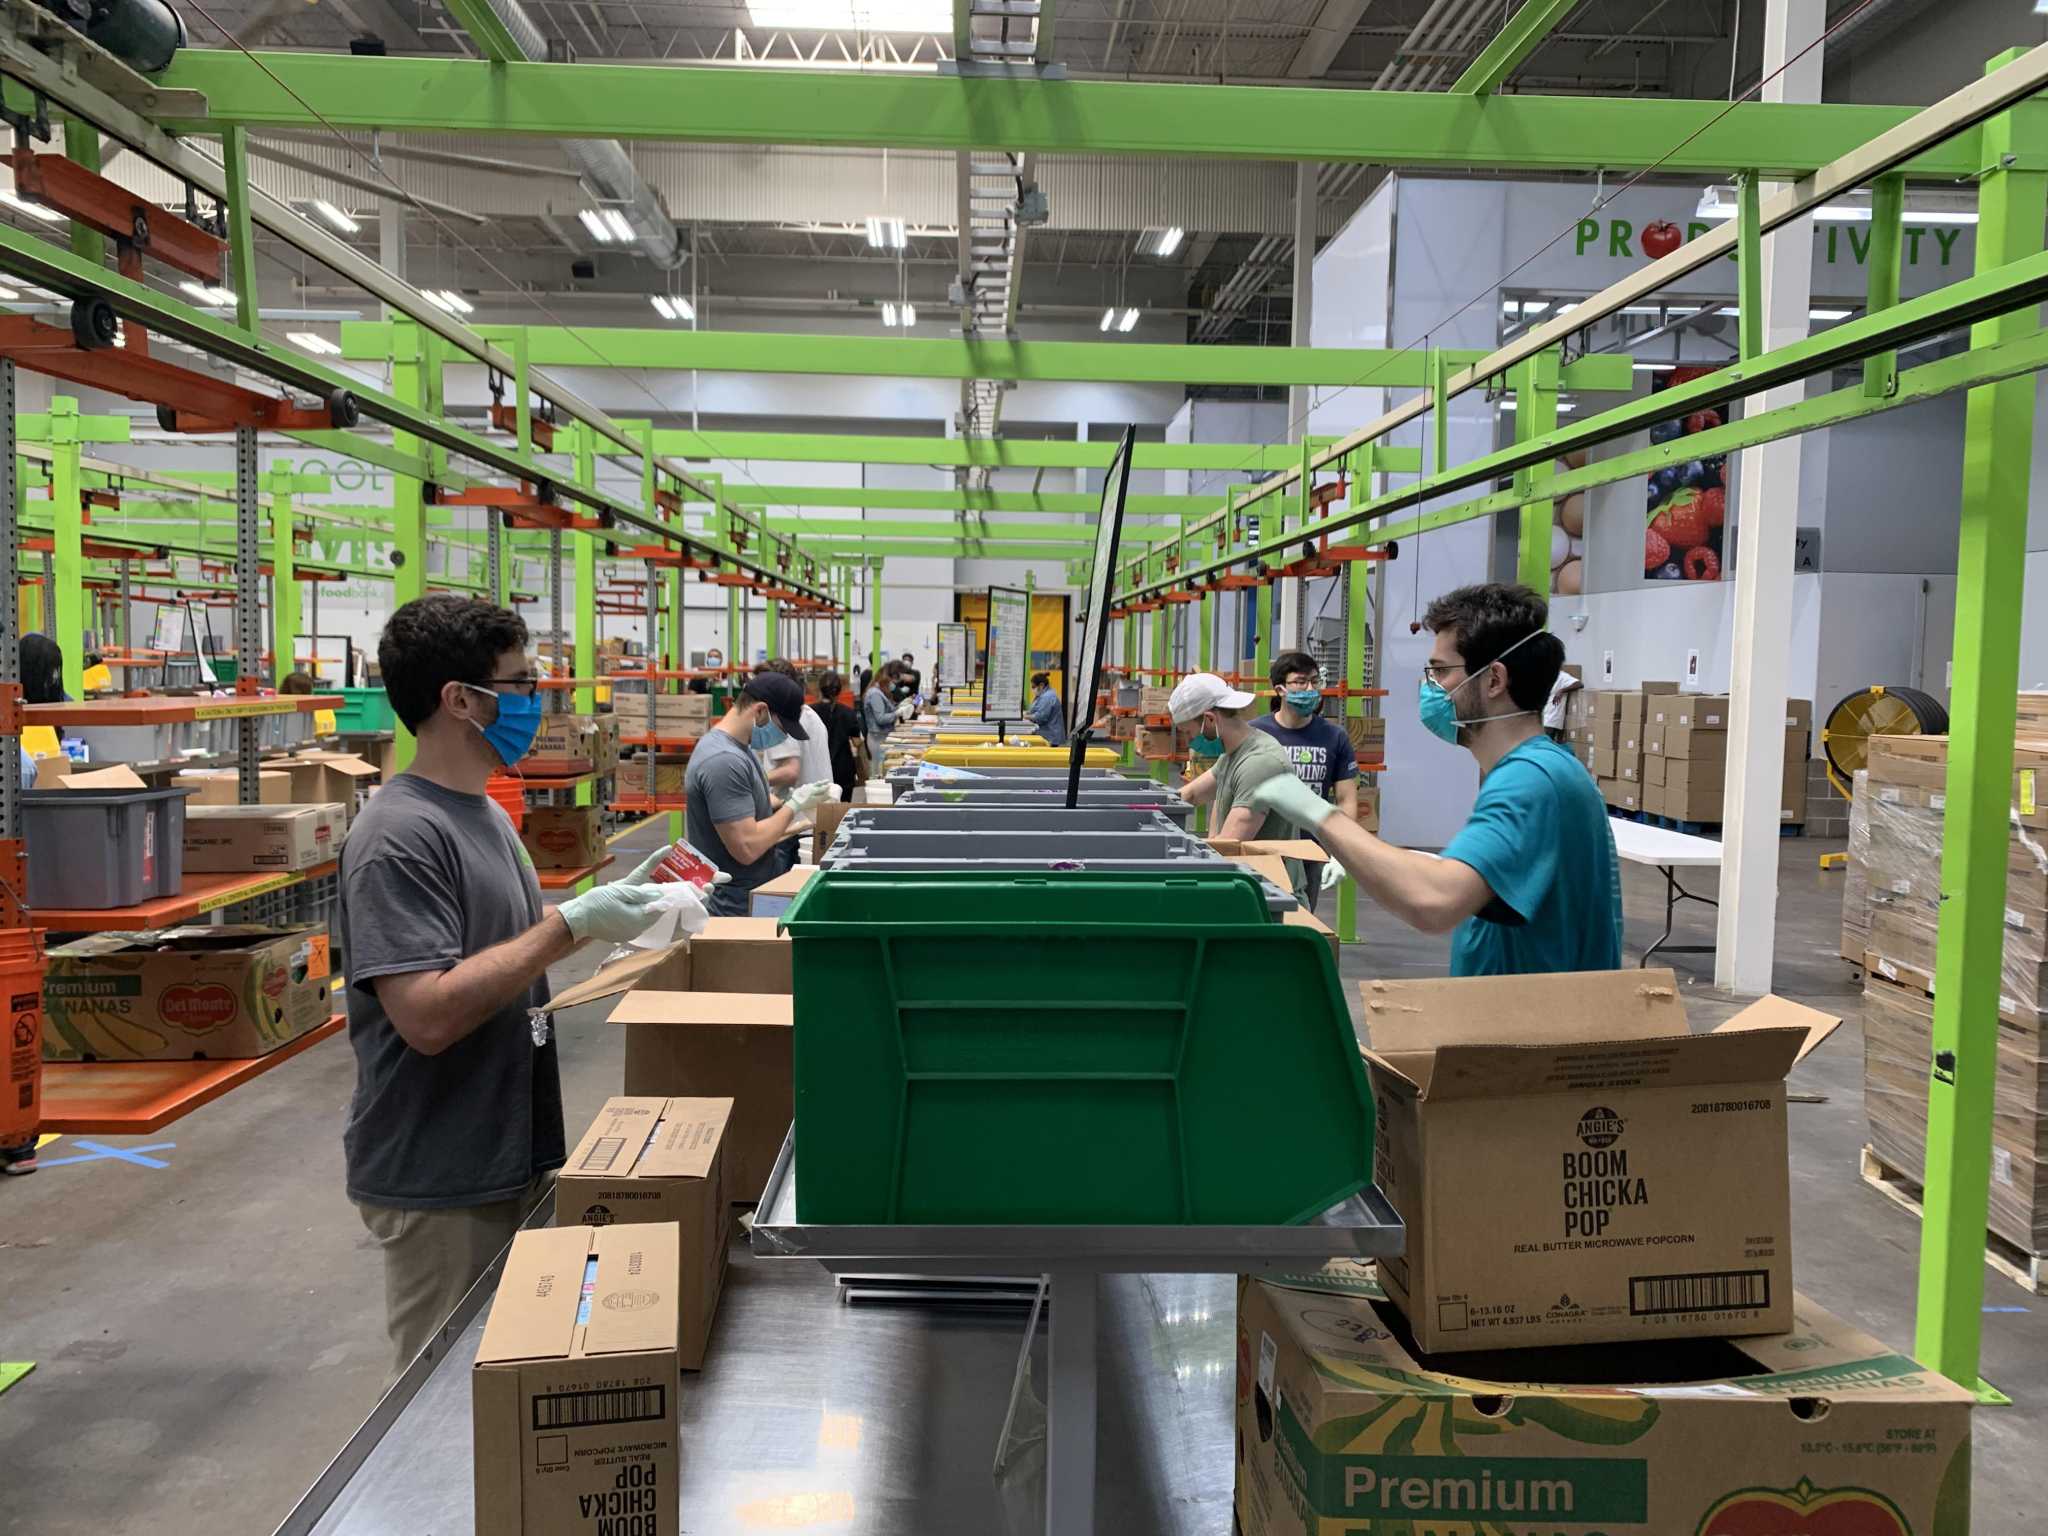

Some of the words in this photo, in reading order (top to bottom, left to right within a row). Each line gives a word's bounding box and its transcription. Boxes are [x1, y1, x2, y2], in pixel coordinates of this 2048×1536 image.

[1563, 1149, 1628, 1180] BOOM
[1564, 1178, 1649, 1209] CHICKA
[1565, 1209, 1610, 1237] POP
[1514, 1243, 1540, 1253] REAL
[1542, 1240, 1582, 1251] BUTTER
[1584, 1236, 1645, 1249] MICROWAVE
[1646, 1234, 1696, 1245] POPCORN
[1886, 1429, 1922, 1439] STORE
[574, 1448, 614, 1456] POPCORN
[616, 1441, 667, 1453] MICROWAVE
[629, 1453, 651, 1463] REAL
[594, 1456, 627, 1466] BUTTER
[615, 1463, 656, 1489] POP
[1344, 1466, 1574, 1511] Premium
[578, 1488, 656, 1518] CHICKA
[598, 1513, 657, 1536] BOOM
